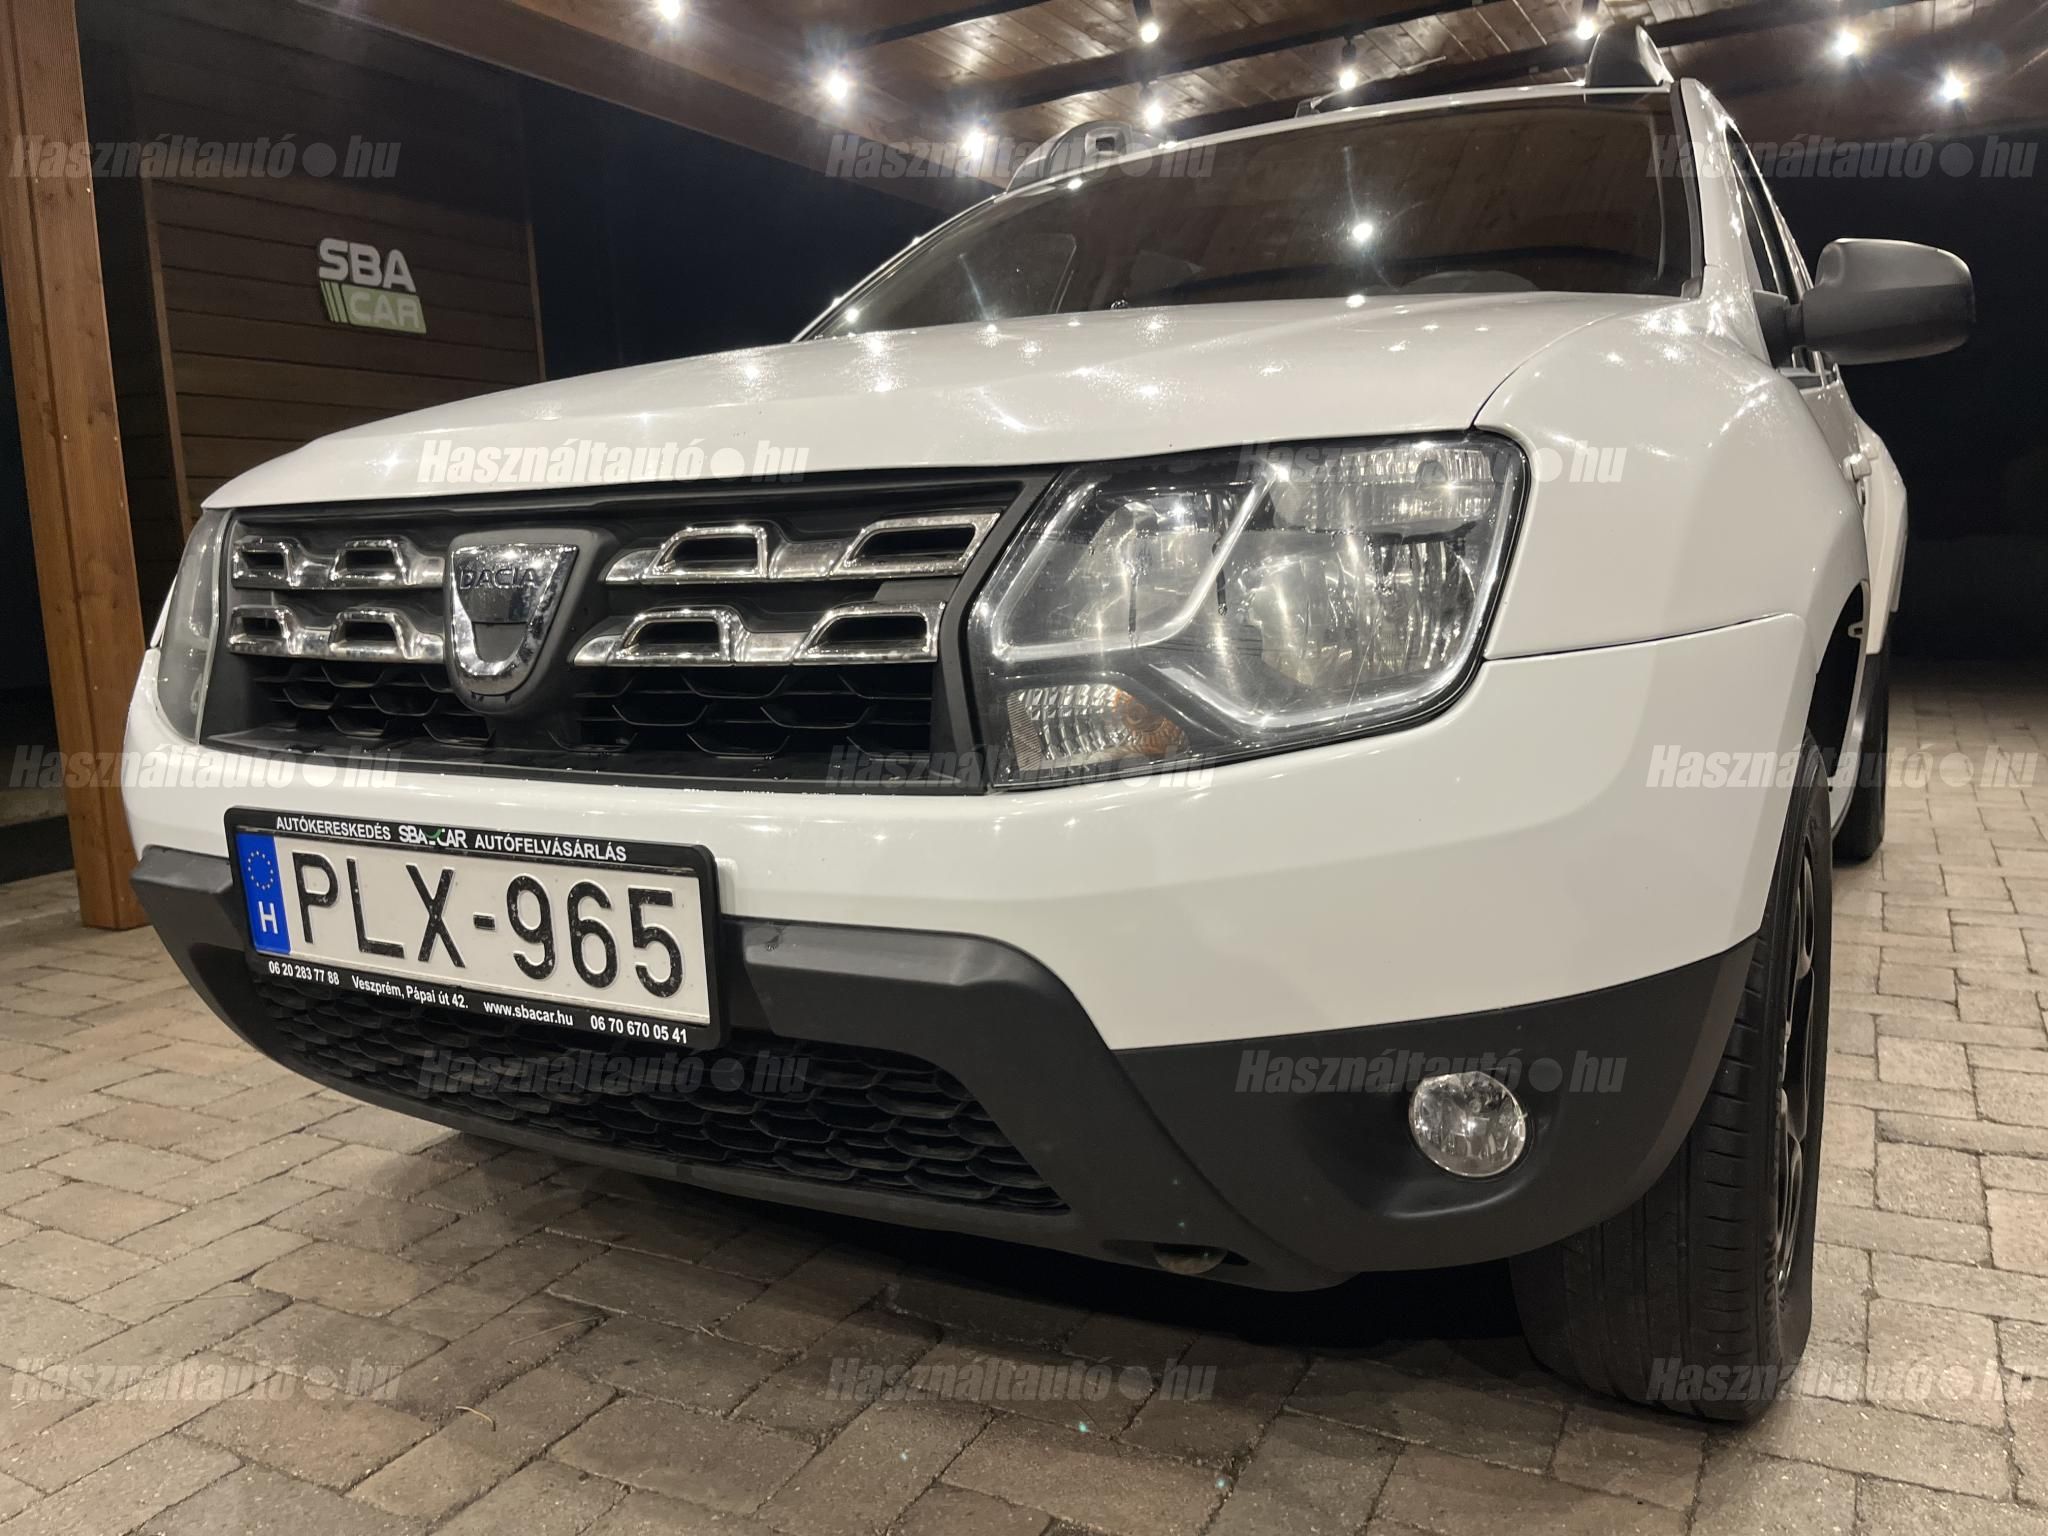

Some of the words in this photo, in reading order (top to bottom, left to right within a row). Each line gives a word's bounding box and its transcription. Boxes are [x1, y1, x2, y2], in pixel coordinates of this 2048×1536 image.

[318, 237, 416, 293] SBA
[350, 291, 421, 329] CAR
[459, 567, 541, 590] DACIA
[276, 816, 391, 841] AUTÓKERESKEDÉS
[474, 833, 627, 862] AUTÓFELVÁSÁRLÁS
[259, 901, 279, 935] H
[292, 851, 685, 999] PLX-965
[268, 961, 280, 975] 06
[282, 963, 293, 977] 20
[295, 965, 312, 980] 283
[313, 968, 324, 983] 77
[328, 971, 340, 985] 88
[352, 975, 404, 999] Veszprém,
[406, 985, 436, 1005] Pápai
[438, 991, 450, 1006] út
[451, 994, 469, 1009] 42.
[484, 1001, 573, 1026] www.sbacar.hu
[590, 1015, 605, 1031] 06
[608, 1017, 624, 1034] 70
[626, 1020, 650, 1038] 670
[653, 1025, 669, 1041] 05
[672, 1028, 687, 1044] 41
